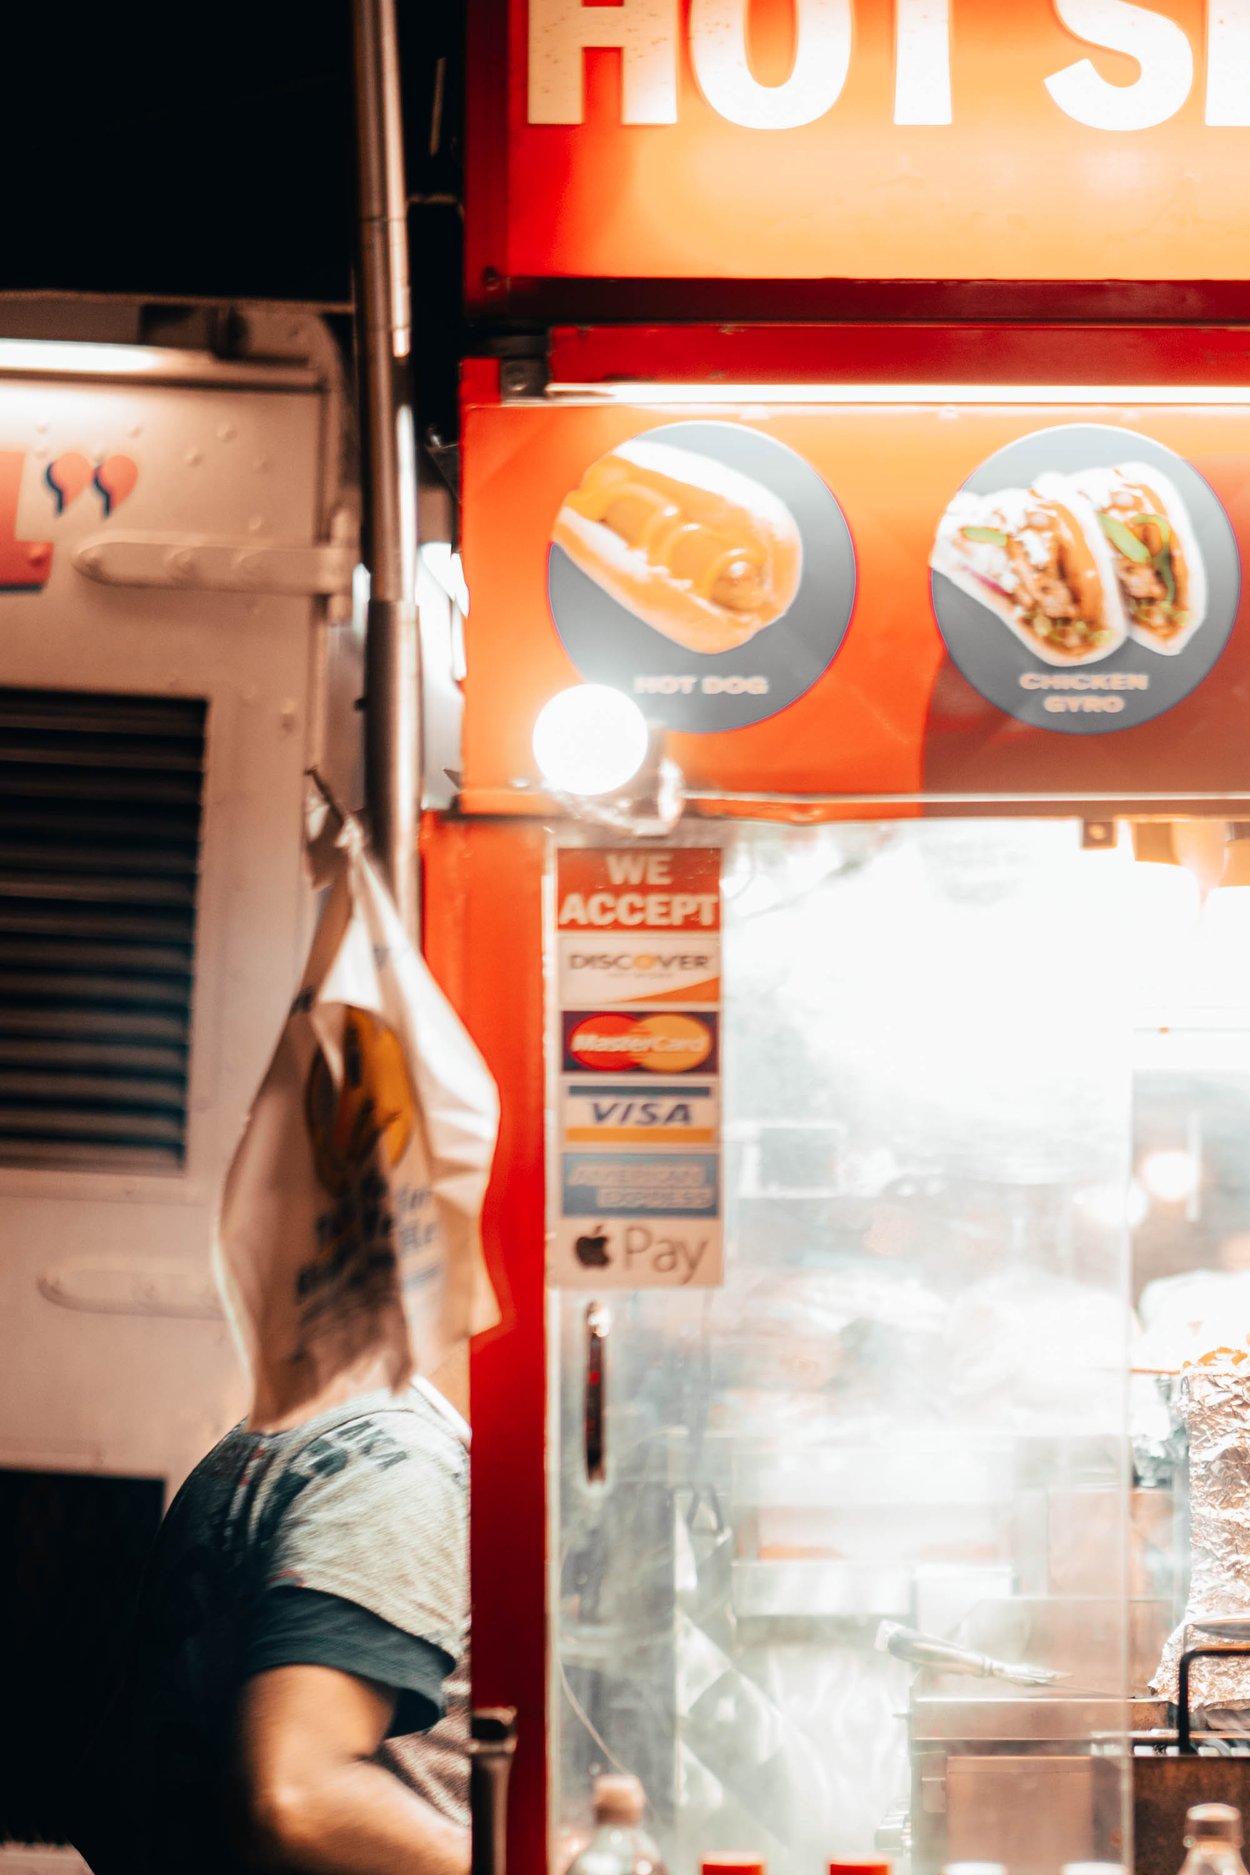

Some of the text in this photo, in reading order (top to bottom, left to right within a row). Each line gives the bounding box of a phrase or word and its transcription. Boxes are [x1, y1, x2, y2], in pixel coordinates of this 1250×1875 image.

[634, 675, 769, 695] HOT DOG
[1019, 673, 1149, 691] CHICKEN
[1044, 695, 1125, 713] GYRO
[605, 854, 673, 885] WE
[558, 892, 718, 926] ACCEPT
[569, 954, 709, 970] DISCOVER
[592, 1103, 691, 1125] VISA
[625, 1226, 708, 1285] Pay
